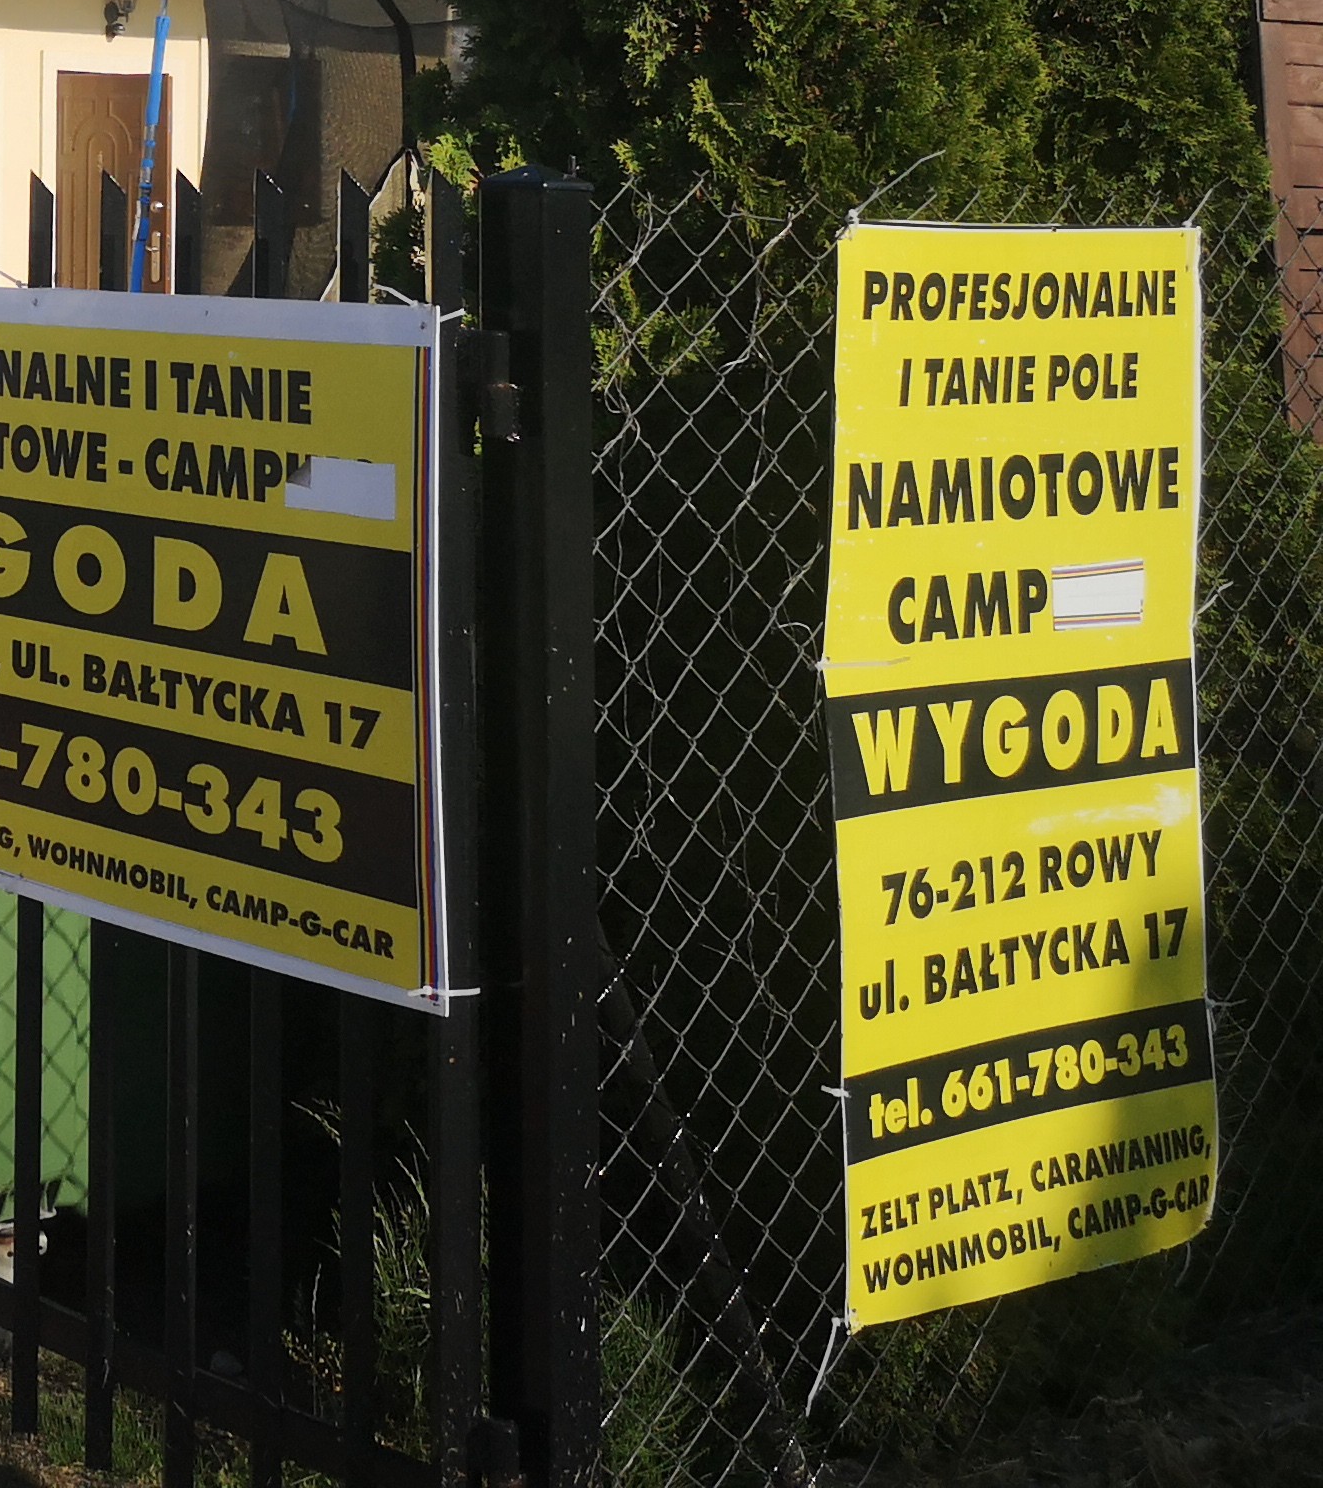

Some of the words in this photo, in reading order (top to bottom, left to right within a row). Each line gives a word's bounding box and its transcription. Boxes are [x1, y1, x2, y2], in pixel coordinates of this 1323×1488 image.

[862, 270, 1176, 321] PROFESJONALNE
[145, 360, 158, 411] I
[170, 361, 313, 425] TANIE
[899, 358, 912, 407] I
[924, 355, 1037, 407] TANIE
[1047, 352, 1139, 402] POLE
[145, 438, 312, 503] CAMP
[847, 446, 1180, 531] NAMIOTOWE
[11, 638, 71, 687] UL.
[82, 651, 305, 737] BAŁTYCKA
[321, 699, 382, 751] 17
[852, 677, 1180, 796] WYGODA
[28, 832, 201, 910] WOHNMOBIL,
[206, 884, 395, 962] CAMP-G-CAR
[881, 850, 1027, 926] 76-212
[1039, 829, 1163, 894] ROWY
[859, 957, 910, 1020] ul.
[924, 918, 1130, 1006] BAŁTYCKA
[1144, 907, 1190, 962] 17
[868, 1075, 933, 1140] tel.
[940, 1024, 1190, 1120] 661-780-343
[860, 1192, 920, 1241] ZELT
[928, 1168, 1023, 1221] PLATZ,
[1030, 1124, 1211, 1193] CARAWANING,
[862, 1216, 1062, 1294] WOHNMOBIL,
[1067, 1173, 1210, 1241] CAMP-G-CAR
